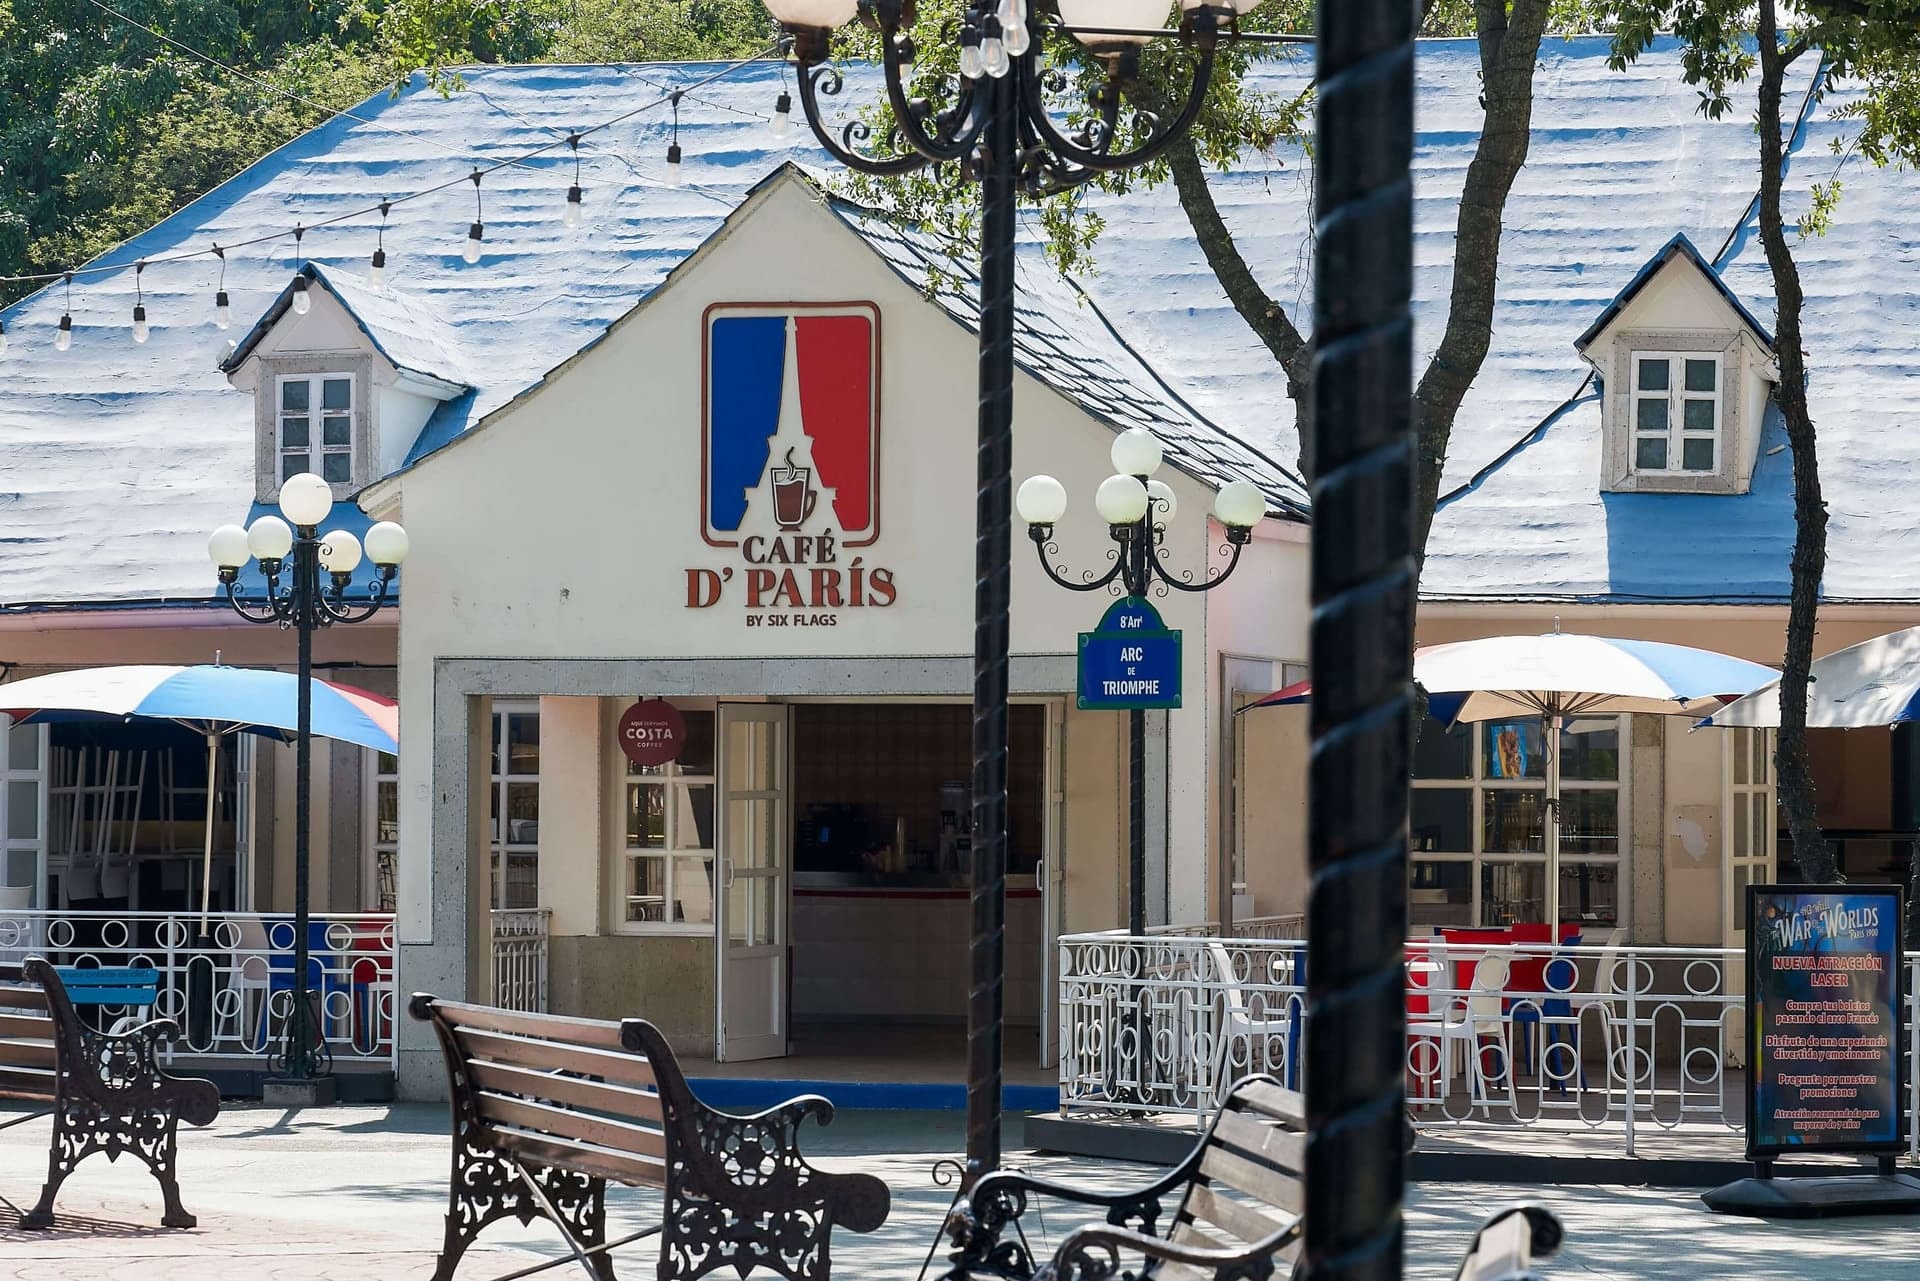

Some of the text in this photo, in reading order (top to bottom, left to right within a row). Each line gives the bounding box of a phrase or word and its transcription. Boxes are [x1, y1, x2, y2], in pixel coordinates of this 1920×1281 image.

[743, 528, 836, 564] CAFÉ
[744, 557, 897, 607] PARÍS
[746, 615, 837, 626] BY SIX FLAGS
[1120, 647, 1143, 661] ARC
[1127, 667, 1136, 675] DE
[1103, 680, 1160, 695] TRIOMPHE
[626, 728, 672, 740] COSTA
[1820, 903, 1878, 938] WORLDS
[1773, 953, 1882, 970] NUEVA ATRACCIÓN
[1811, 973, 1848, 987] LASER
[1786, 1000, 1870, 1014] Compra tus boletos
[1776, 1012, 1879, 1026] pasando el arco Francés
[1766, 1034, 1888, 1050] Disfruta de una experiencia
[1774, 1048, 1880, 1062] divertida y emocionante
[1778, 1073, 1877, 1086] Pregunta por nuestras
[1800, 1086, 1857, 1099] promociones
[1774, 1108, 1880, 1120] Atracción recomendada para
[1793, 1121, 1826, 1131] mayores
[1826, 1119, 1836, 1130] de
[1842, 1119, 1860, 1130] años
